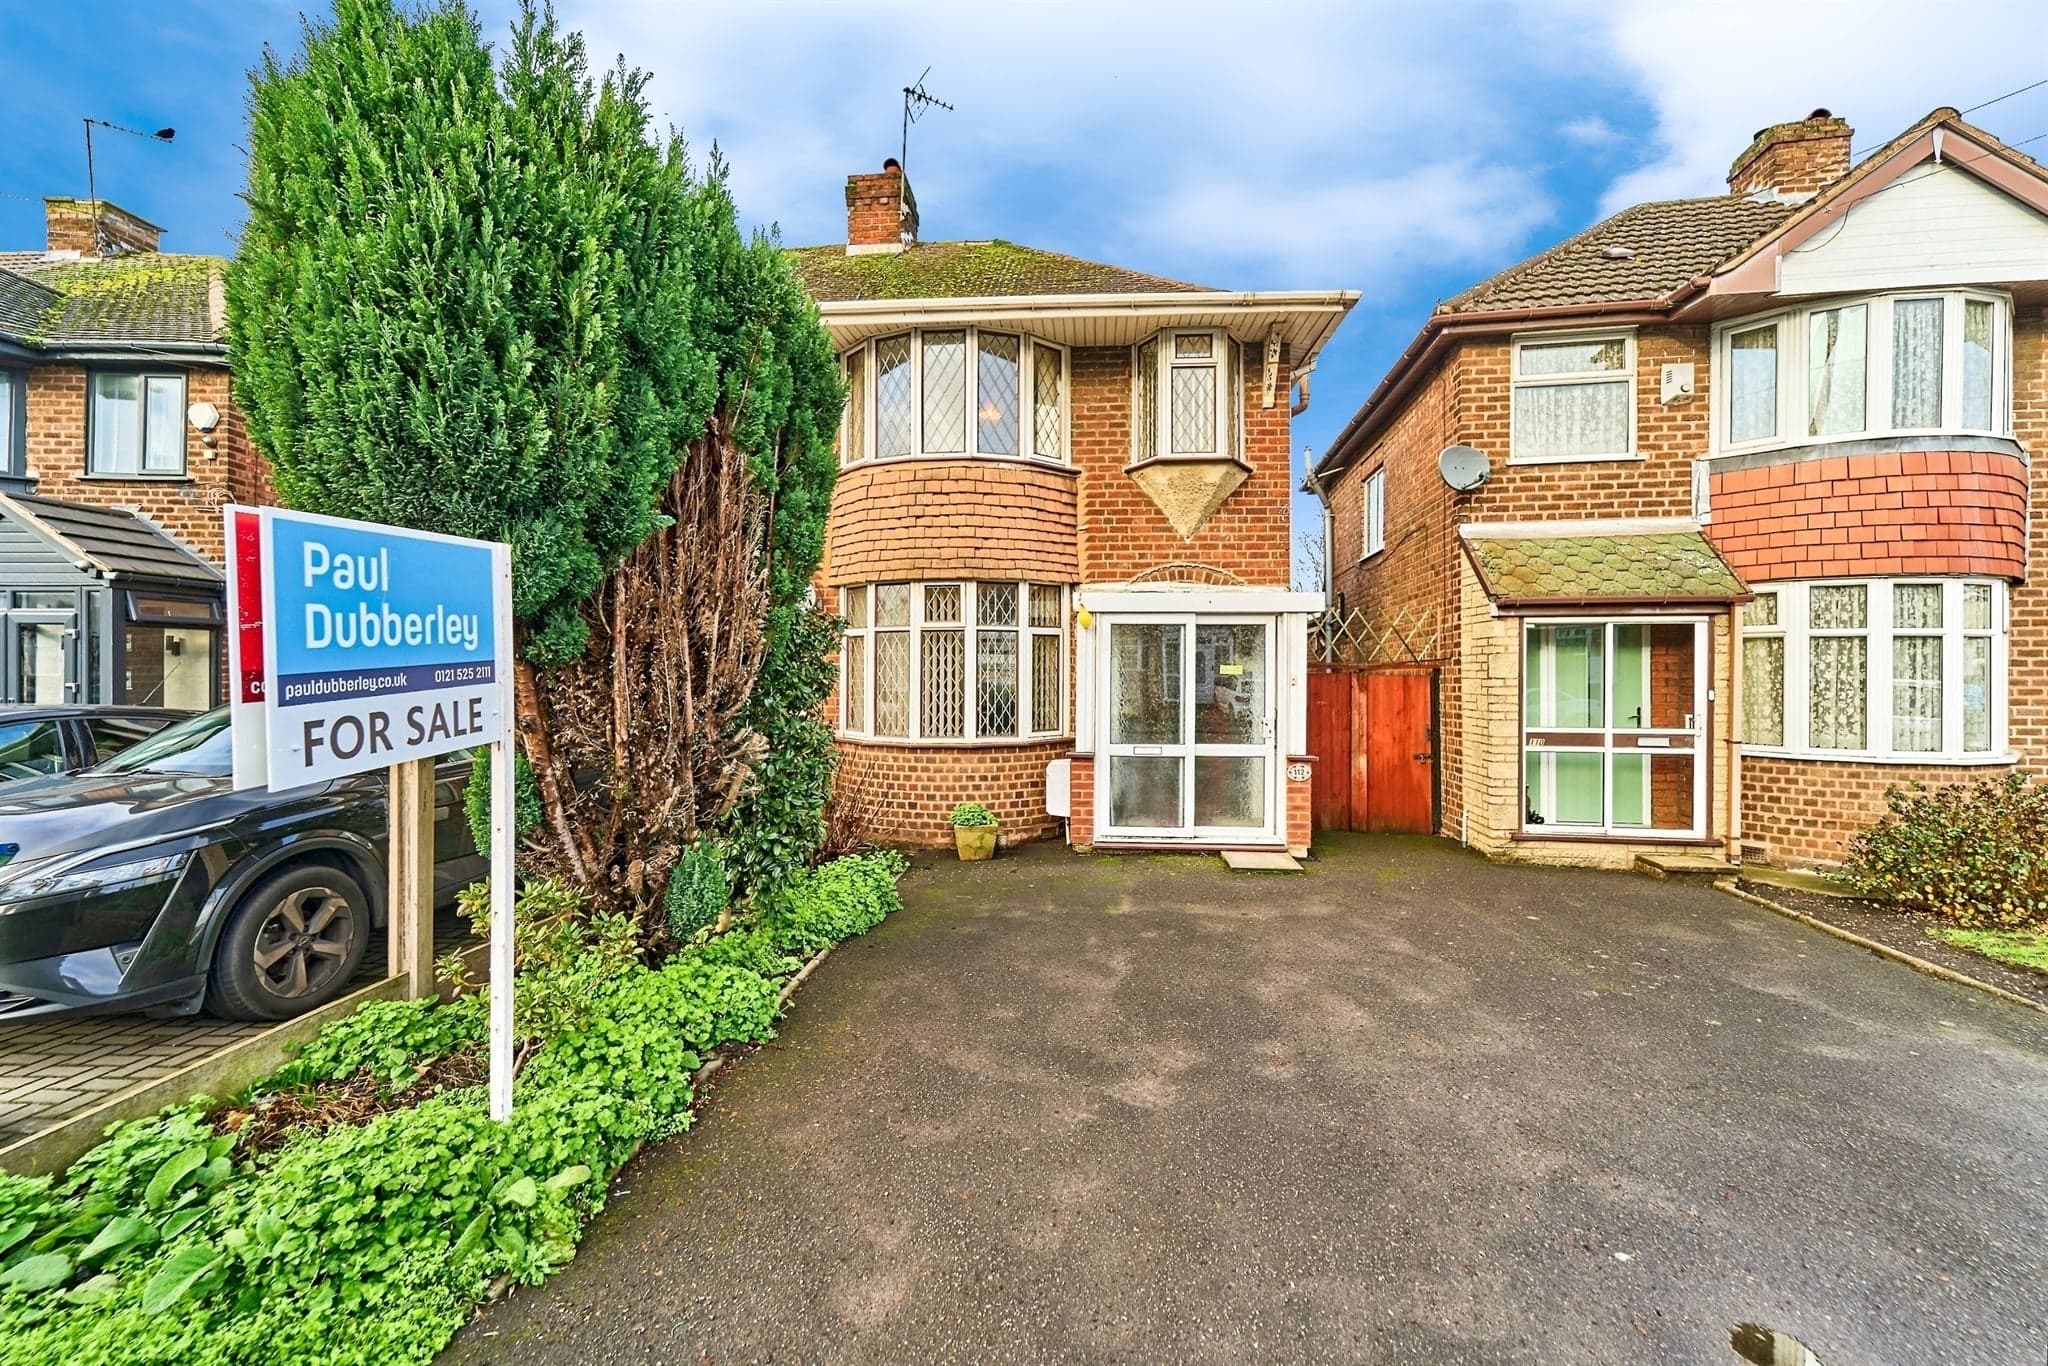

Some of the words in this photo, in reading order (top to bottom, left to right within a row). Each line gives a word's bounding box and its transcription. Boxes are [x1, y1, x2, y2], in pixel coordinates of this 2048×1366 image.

[303, 541, 389, 592] Paul
[305, 602, 479, 651] Dubberley
[285, 673, 408, 700] pauldubberley.co.uk
[435, 669, 454, 682] 0121
[457, 667, 474, 680] 525
[476, 666, 491, 679] 2111
[303, 711, 394, 767] FOR
[406, 697, 483, 746] SALE
